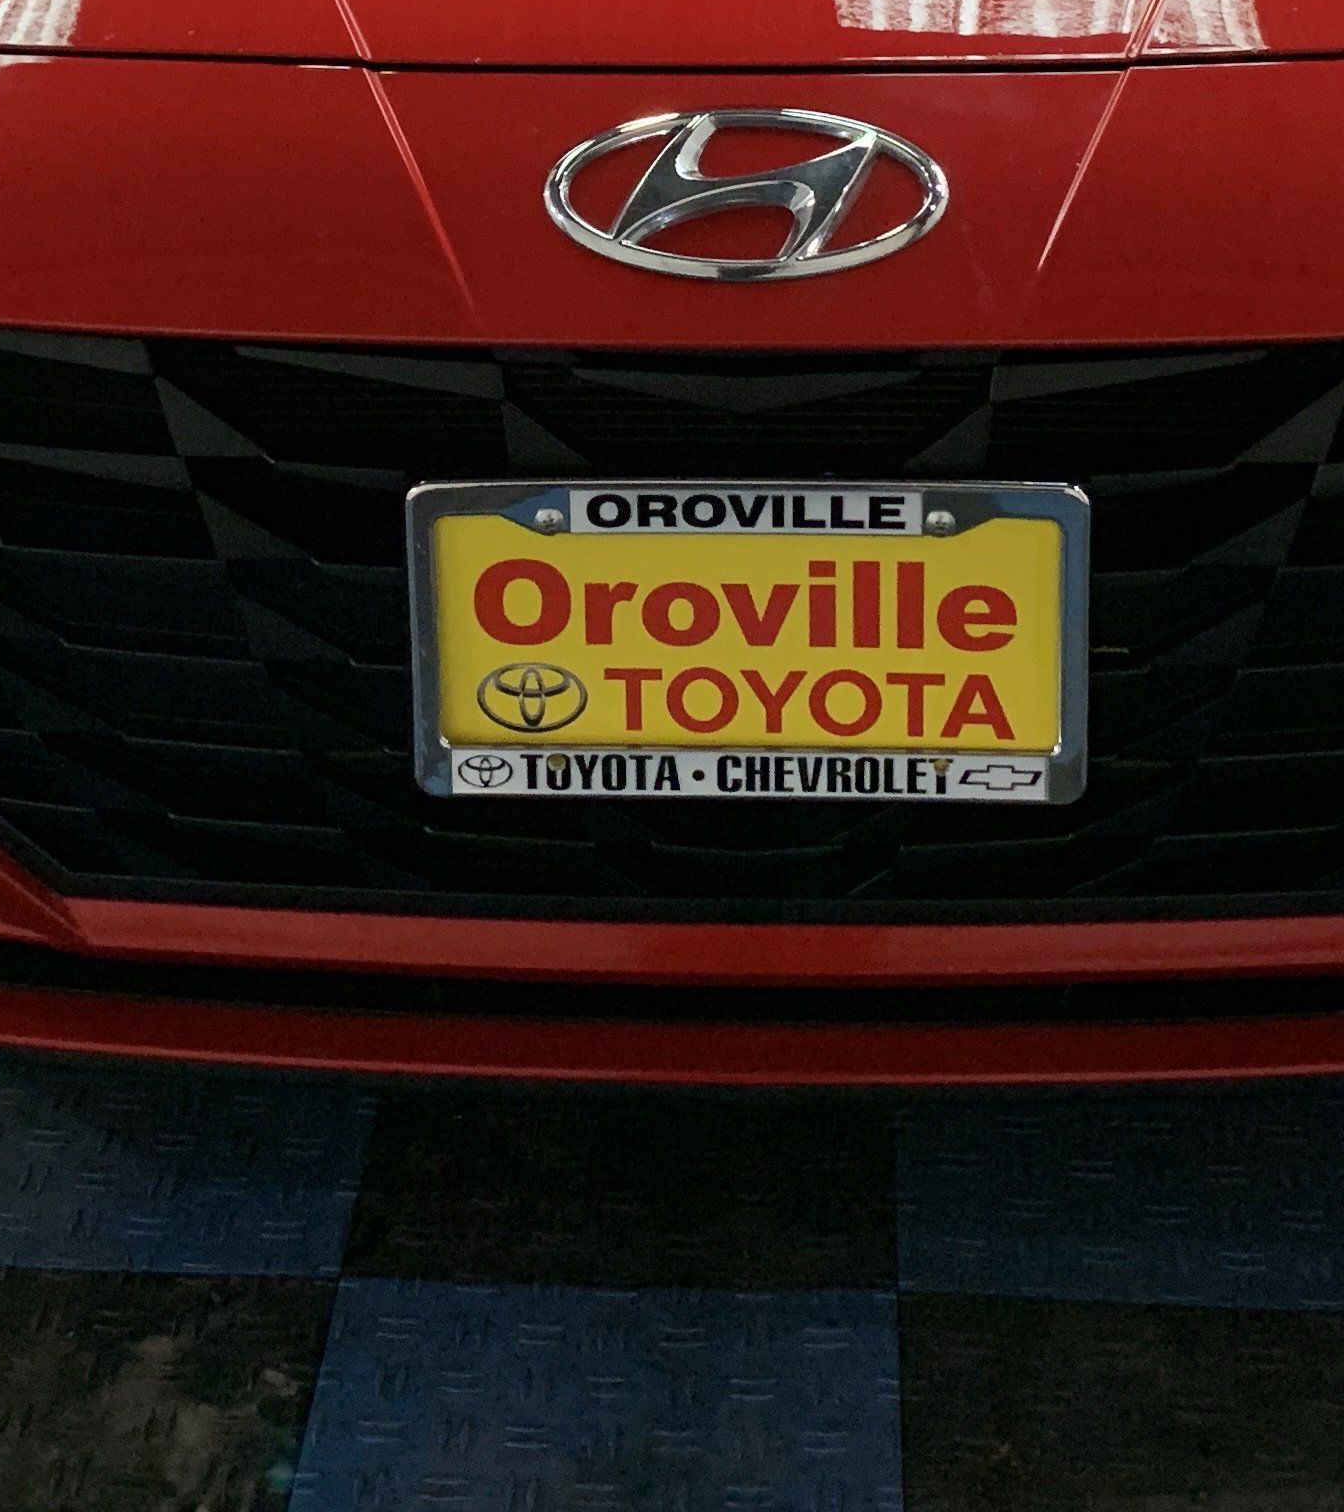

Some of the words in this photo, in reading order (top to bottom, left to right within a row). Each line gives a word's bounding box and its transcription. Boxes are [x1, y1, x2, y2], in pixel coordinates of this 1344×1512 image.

[585, 493, 906, 530] OROVILLE
[473, 557, 1018, 653] Oroville
[603, 665, 1016, 741] TOYOTA
[519, 752, 681, 791] TOYOTA
[716, 754, 955, 796] CHEVROLET
